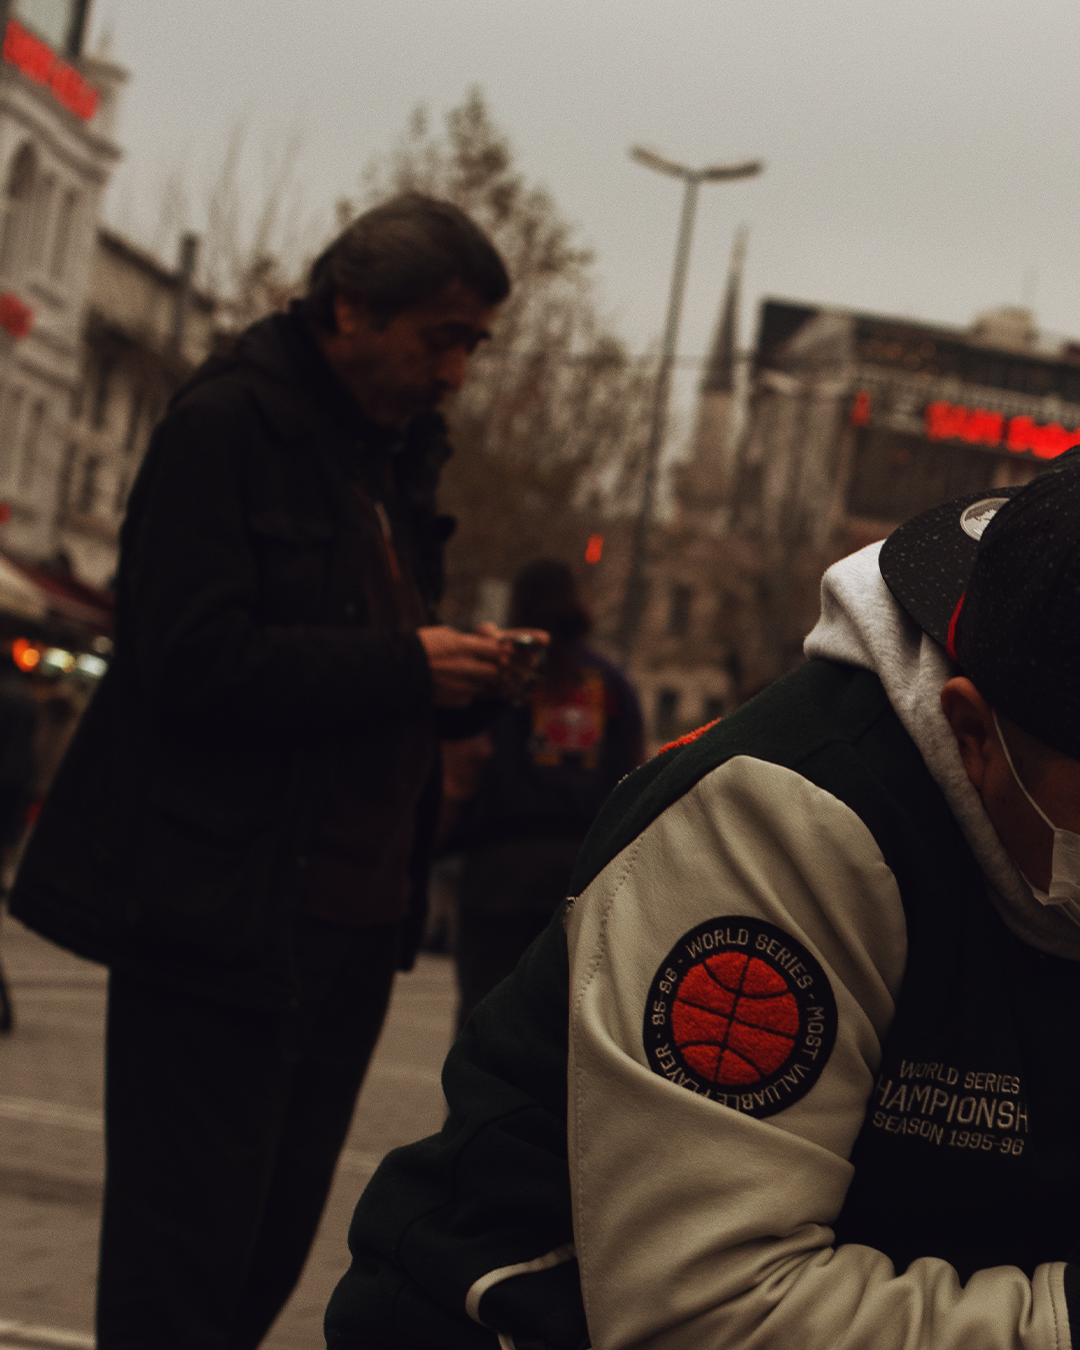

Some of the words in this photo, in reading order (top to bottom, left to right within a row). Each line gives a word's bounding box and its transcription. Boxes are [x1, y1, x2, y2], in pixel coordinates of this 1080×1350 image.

[685, 928, 749, 959] WORLD
[755, 933, 814, 990] SERIES
[805, 1005, 826, 1061] MOST
[716, 1063, 811, 1111] VALUABLE
[899, 1059, 959, 1086] WORLD
[964, 1071, 1021, 1095] SERIES
[872, 1110, 945, 1146] SEASON
[948, 1128, 1025, 1157] 1995-96
